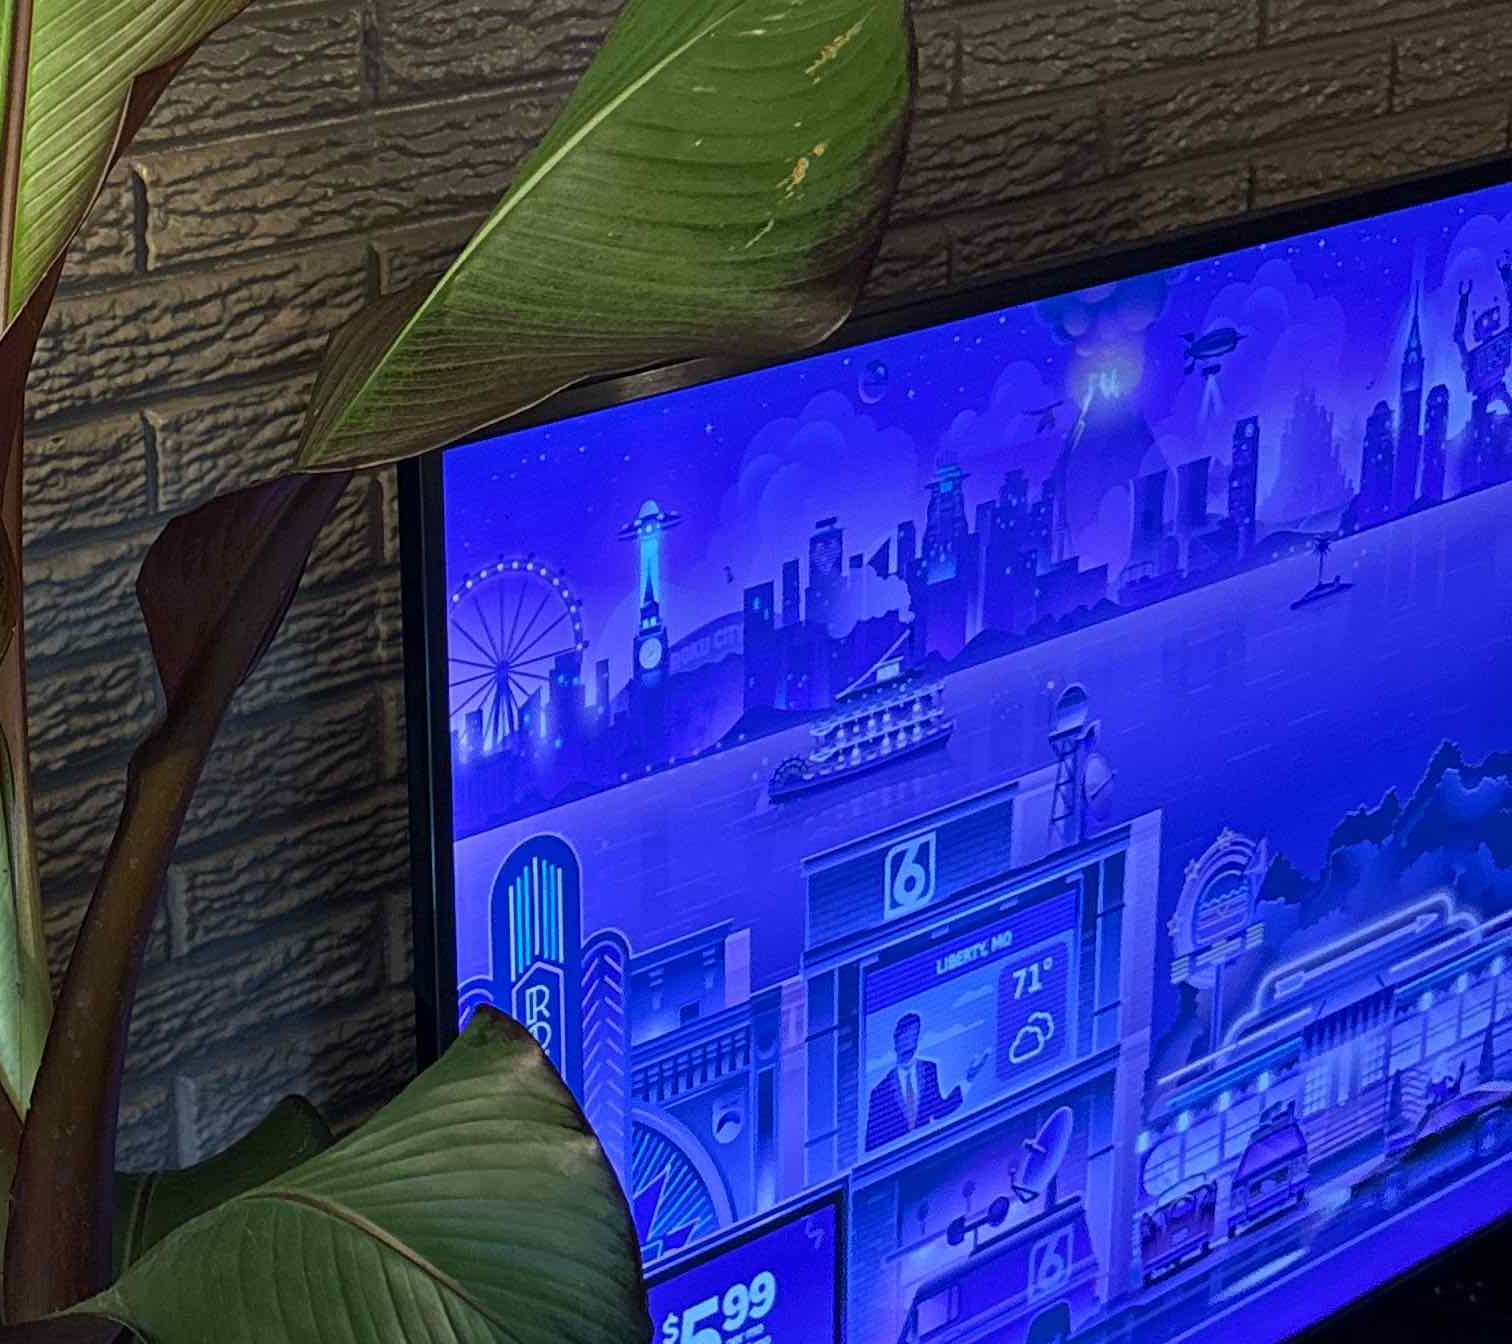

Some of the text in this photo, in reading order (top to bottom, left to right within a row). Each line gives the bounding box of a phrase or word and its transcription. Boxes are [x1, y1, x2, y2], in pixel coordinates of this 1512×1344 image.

[893, 842, 926, 907] 6
[936, 930, 1013, 976] LIBERTY, MO
[1013, 956, 1054, 1000] 71°
[1038, 1232, 1065, 1289] 6
